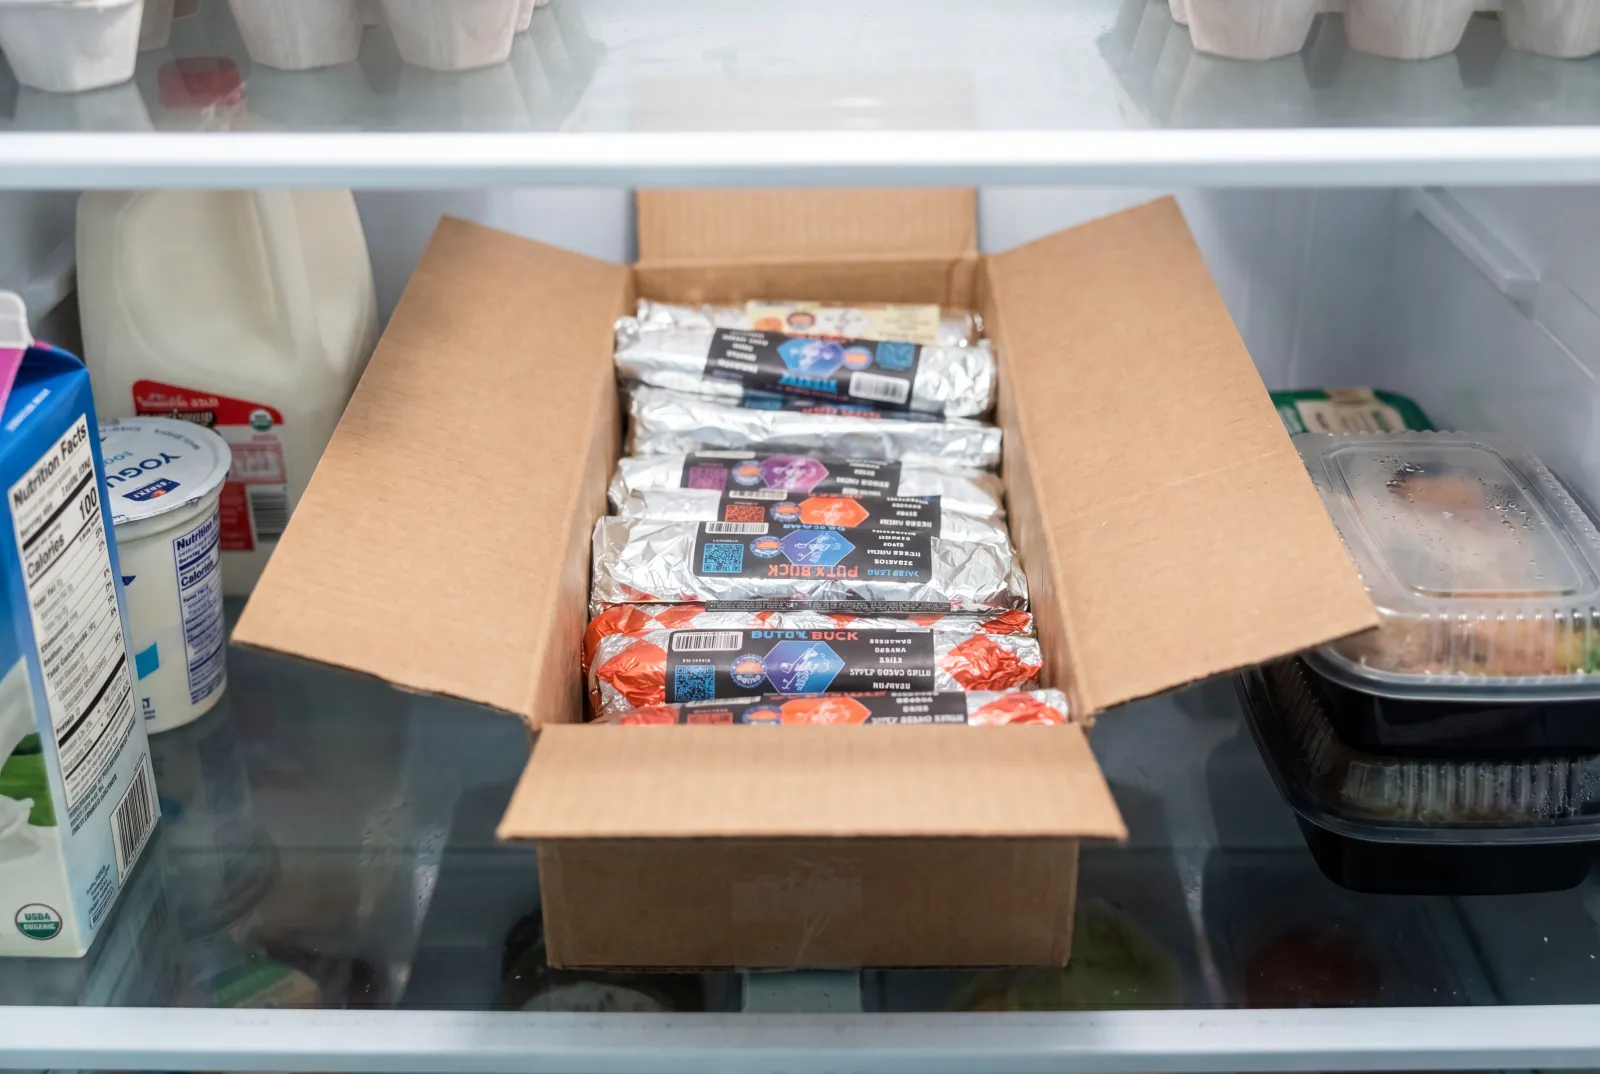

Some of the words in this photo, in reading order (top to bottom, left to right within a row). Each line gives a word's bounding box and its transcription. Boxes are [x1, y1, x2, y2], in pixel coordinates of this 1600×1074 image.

[12, 455, 60, 509] Nutrition
[60, 423, 87, 461] Facts
[79, 486, 97, 520] 100
[27, 534, 65, 578] Calories
[767, 564, 811, 577] BUCK
[811, 631, 859, 641] BUCK
